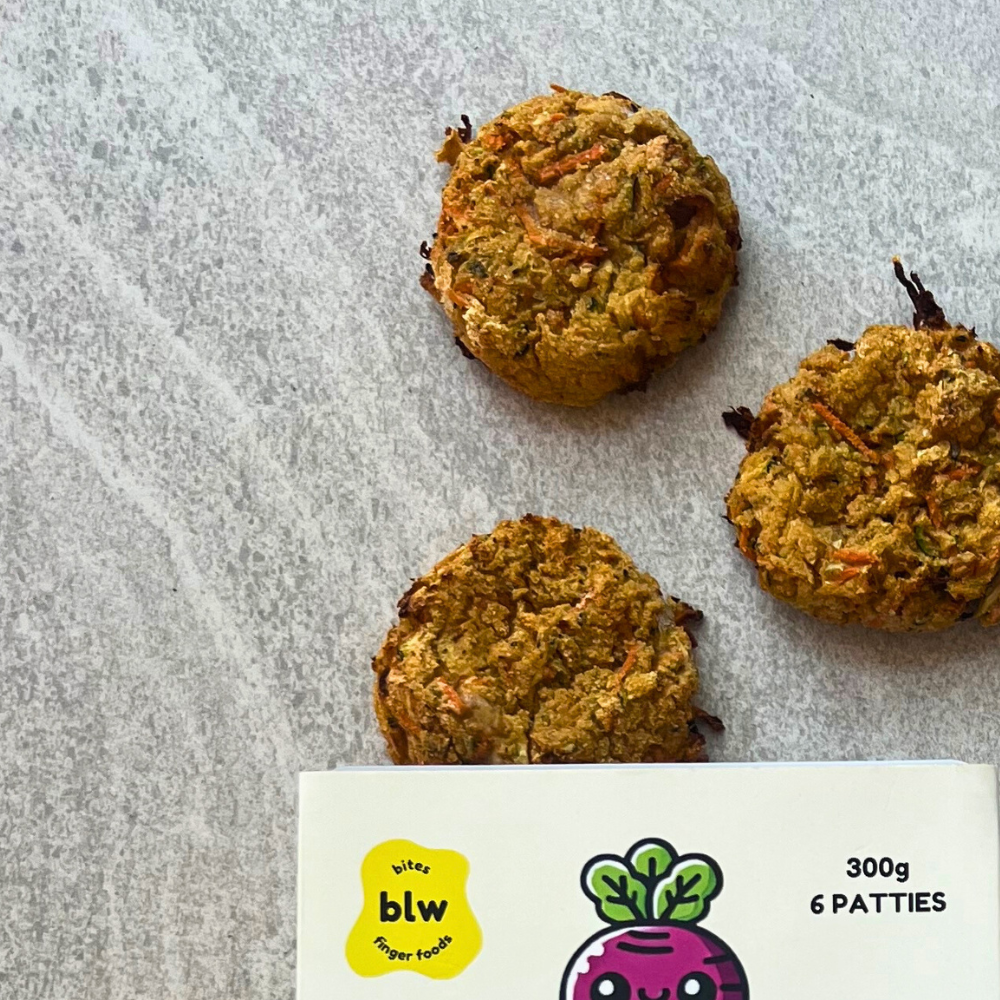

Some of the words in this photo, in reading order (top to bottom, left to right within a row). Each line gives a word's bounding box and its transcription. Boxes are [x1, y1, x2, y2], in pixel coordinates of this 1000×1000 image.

[391, 859, 431, 876] bites
[846, 856, 910, 883] 300g
[379, 890, 449, 923] blw
[810, 893, 825, 915] 6
[832, 891, 947, 914] PATTIES
[373, 936, 414, 962] finger
[415, 935, 453, 961] foods
